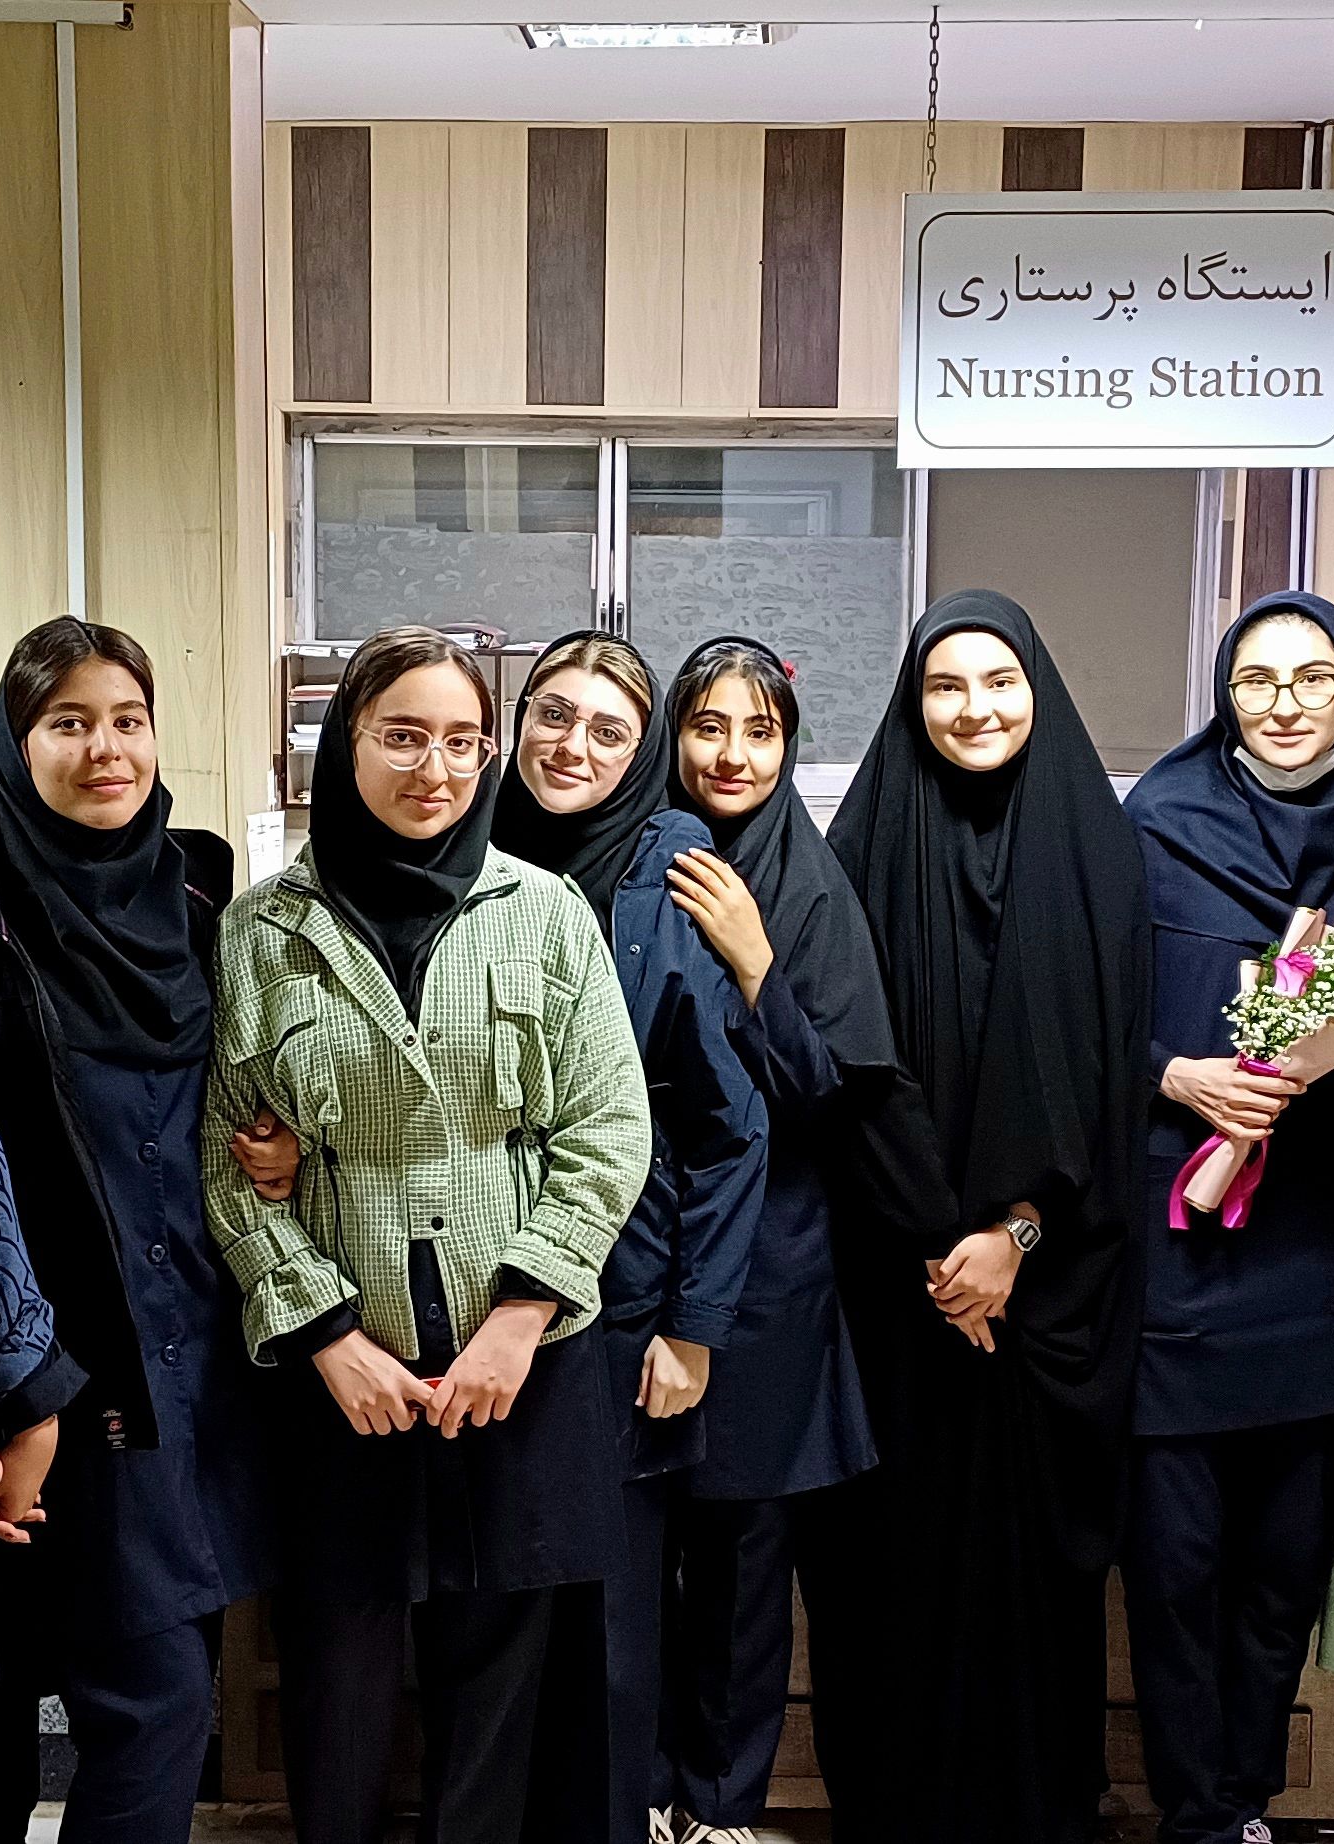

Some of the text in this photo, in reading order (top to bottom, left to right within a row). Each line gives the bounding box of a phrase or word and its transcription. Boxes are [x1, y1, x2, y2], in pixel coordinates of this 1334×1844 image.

[937, 251, 1332, 322] ایستگاه پرستاری
[936, 354, 1324, 409] Nursing Station
